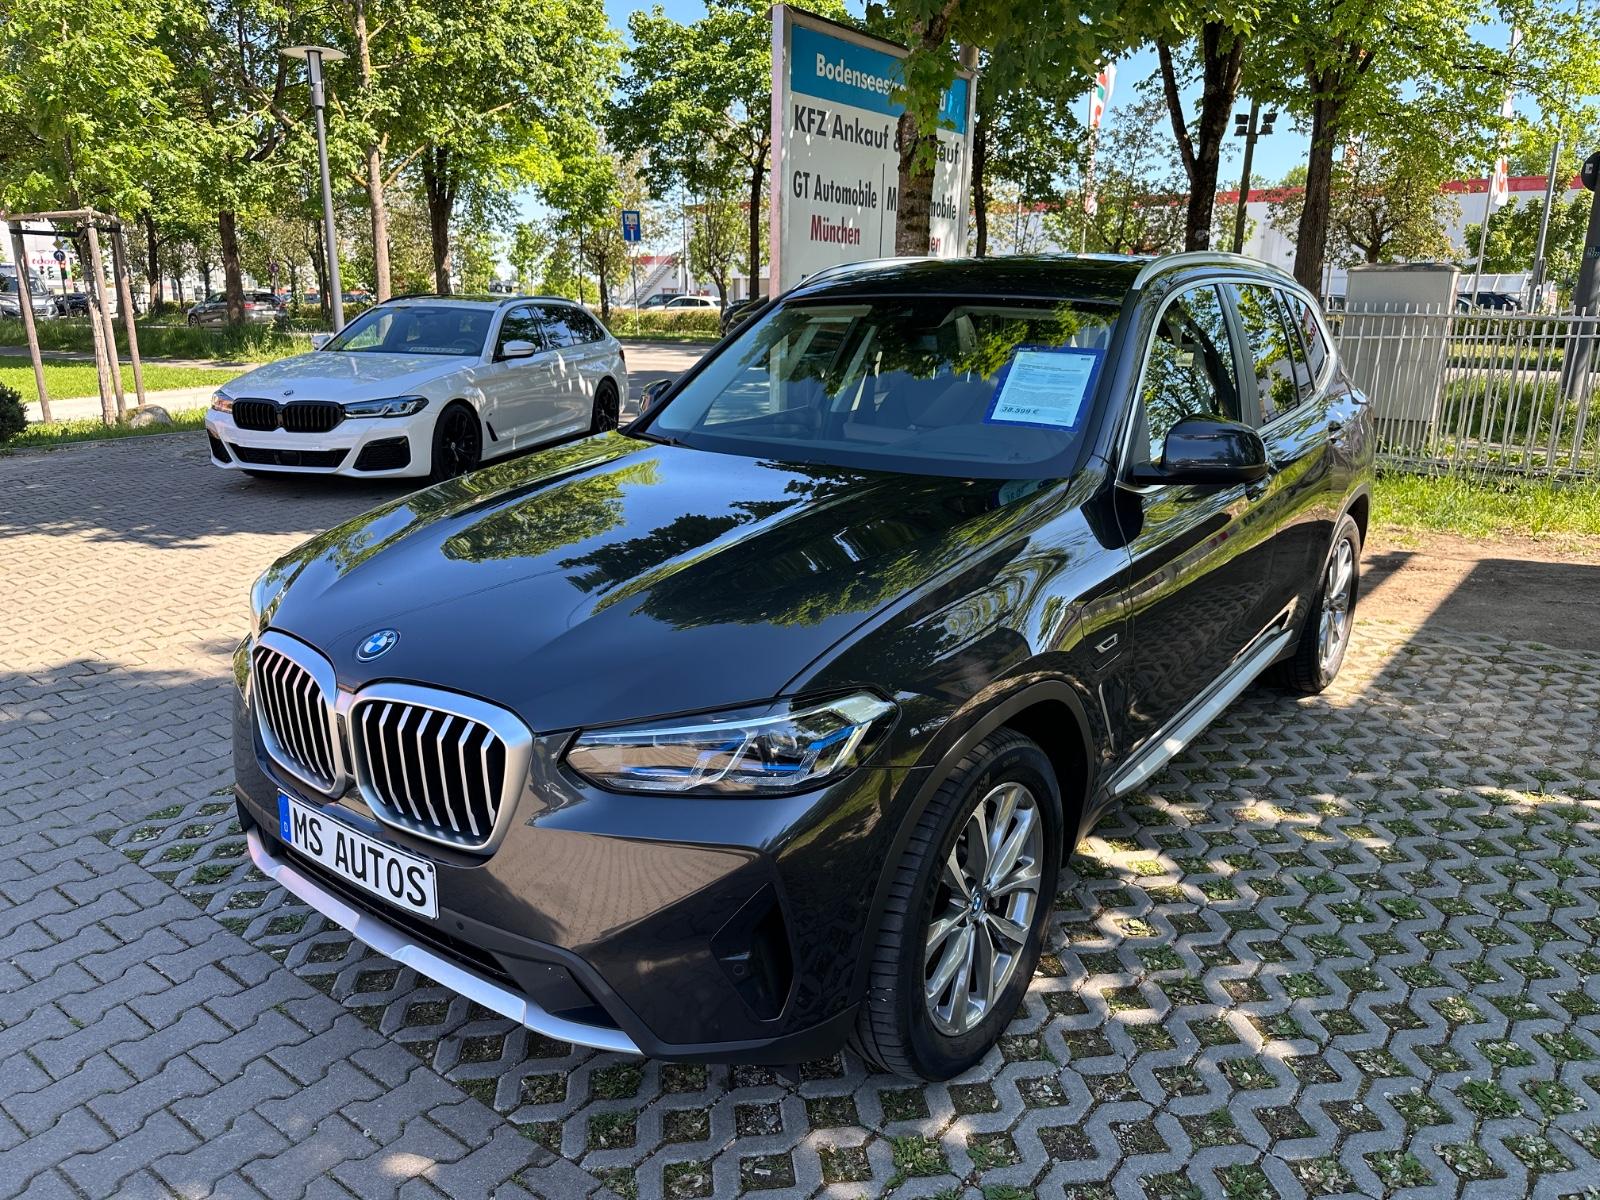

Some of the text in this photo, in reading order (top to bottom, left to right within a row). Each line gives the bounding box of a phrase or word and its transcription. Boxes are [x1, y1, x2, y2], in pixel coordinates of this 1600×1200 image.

[794, 104, 827, 137] KFZ
[832, 114, 889, 150] Ankauf
[793, 170, 877, 209] GT Automobile
[810, 214, 860, 245] München
[293, 807, 427, 907] MS AUTOS
